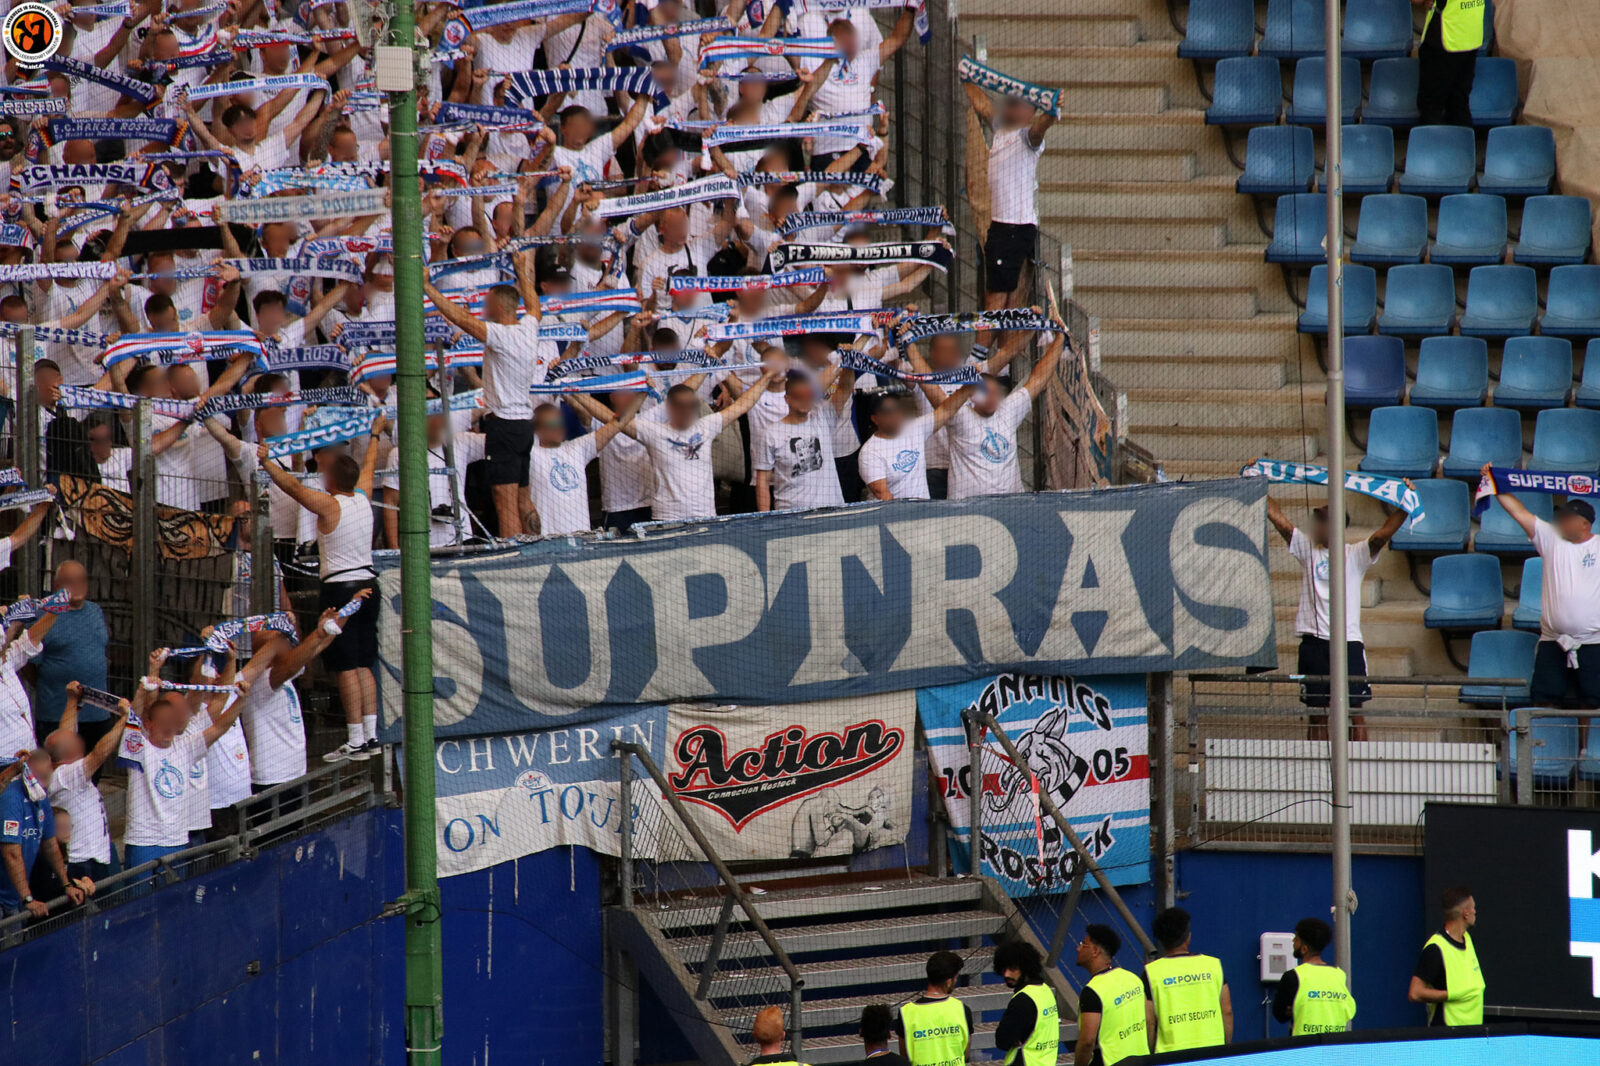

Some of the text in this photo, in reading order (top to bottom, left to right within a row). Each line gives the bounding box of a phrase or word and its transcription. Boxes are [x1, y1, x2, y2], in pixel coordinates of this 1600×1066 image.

[21, 164, 136, 186] FC HANSA
[229, 202, 290, 221] OSTSEE
[789, 244, 913, 260] FC HANSA ROSTOCK
[673, 276, 743, 291] OSTSEE
[1508, 473, 1567, 490] SUPER
[376, 493, 1272, 730] SUPTRAS
[436, 720, 657, 774] CHWERIN
[669, 720, 904, 791] Action
[1092, 747, 1130, 783] 05
[707, 777, 797, 800] Connection Rostock
[444, 813, 501, 853] ON
[981, 815, 1116, 890] ROSTOK
[1178, 973, 1212, 983] POWER
[1168, 1010, 1217, 1025] EVENT SECURITY
[928, 1026, 960, 1037] POWER
